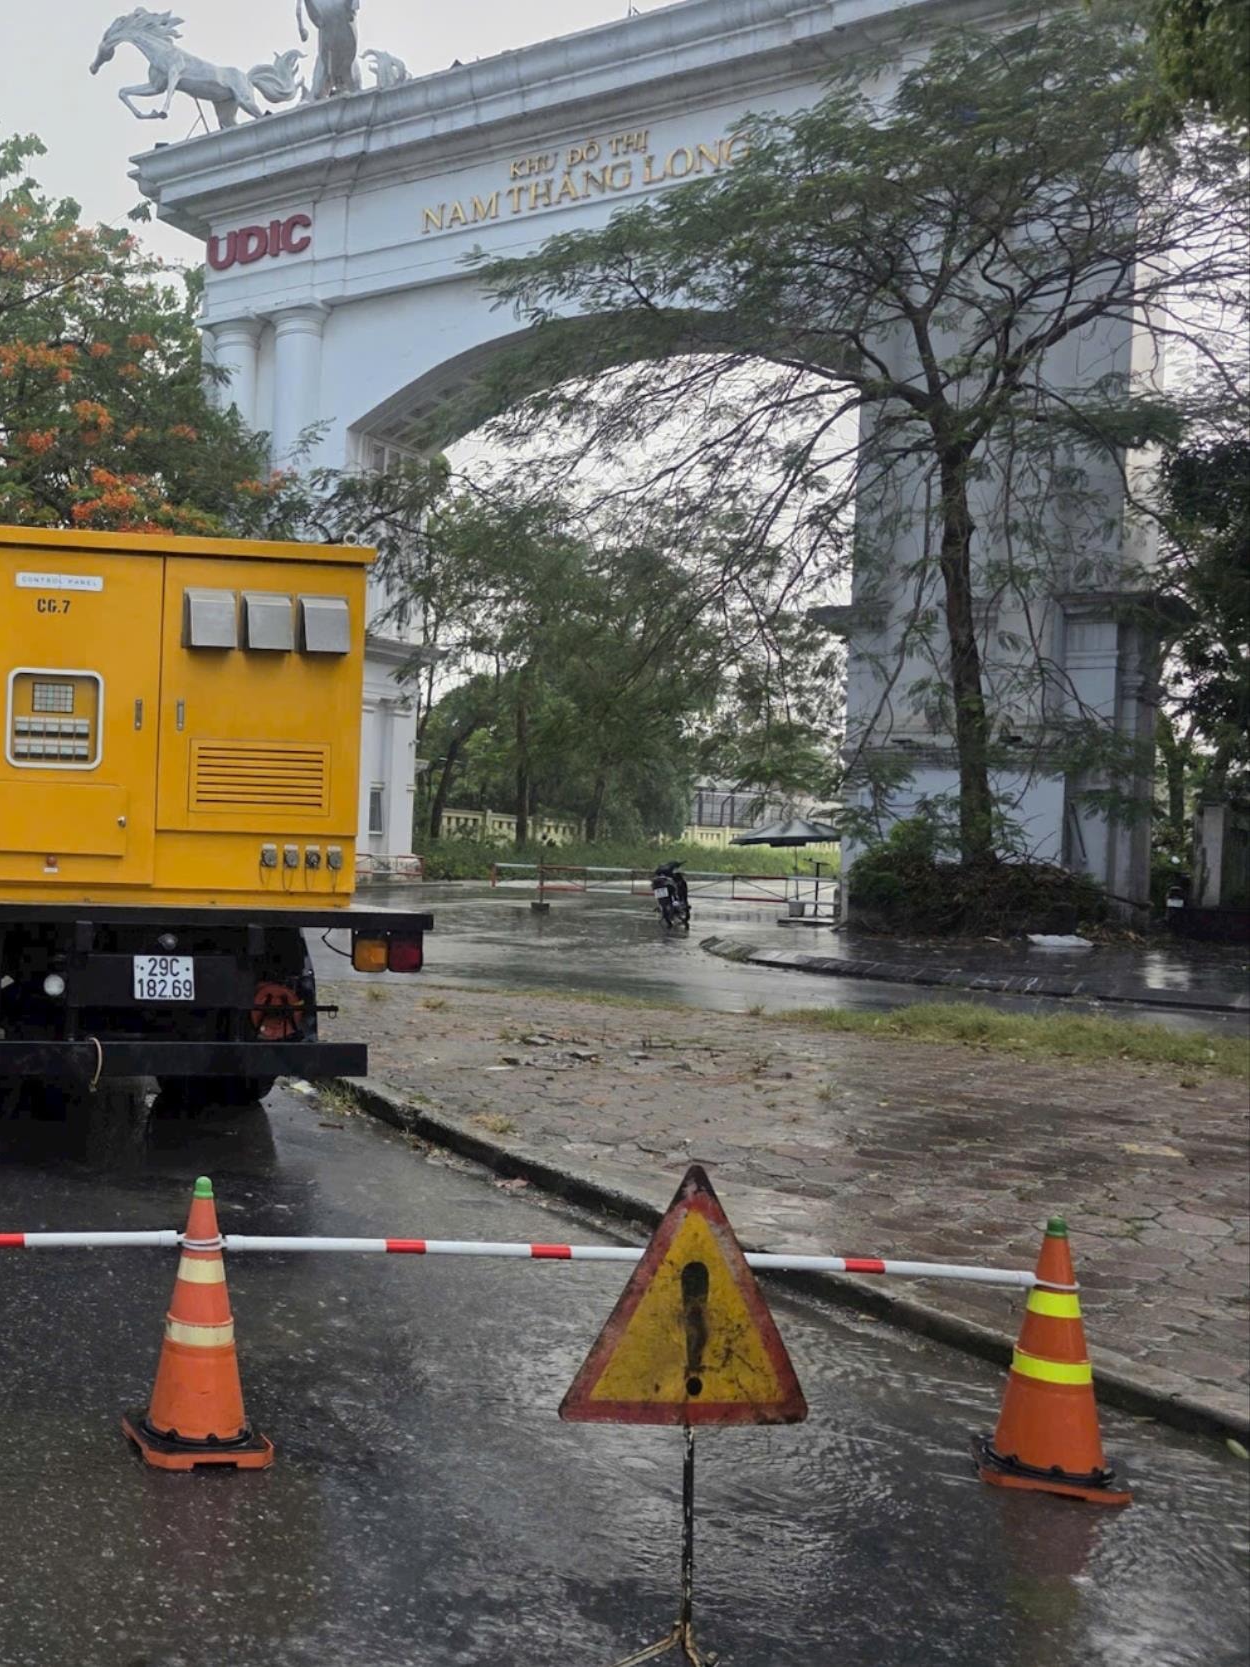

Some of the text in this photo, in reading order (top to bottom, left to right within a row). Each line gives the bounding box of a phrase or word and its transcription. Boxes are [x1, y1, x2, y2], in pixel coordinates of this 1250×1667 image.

[510, 129, 649, 180] KHU ĐÔ THỊ
[422, 190, 502, 234] NAM
[643, 132, 751, 185] LONG
[207, 214, 312, 271] UDIC
[37, 598, 71, 614] CG.7
[148, 957, 180, 977] 29C
[137, 978, 193, 998] 182.69
